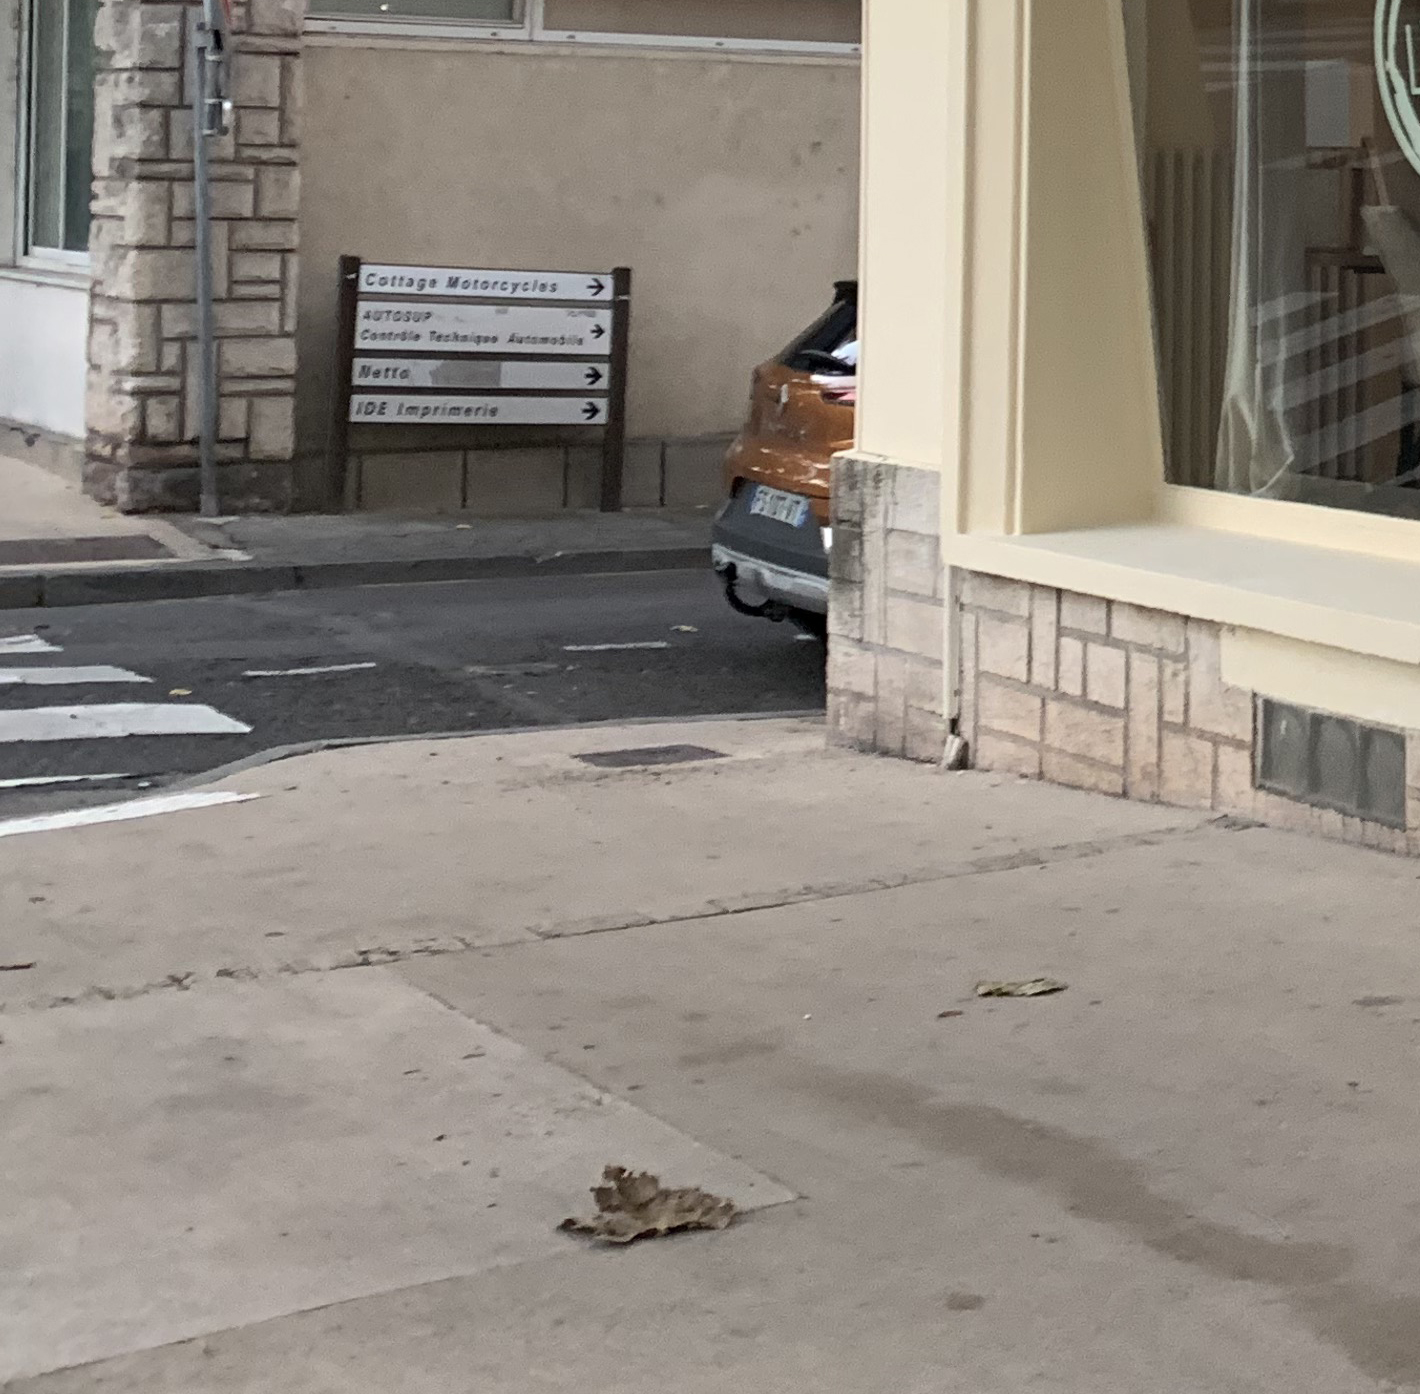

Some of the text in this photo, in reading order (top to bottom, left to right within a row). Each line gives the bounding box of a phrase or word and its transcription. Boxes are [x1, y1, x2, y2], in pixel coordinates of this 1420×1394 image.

[365, 273, 558, 294] Cottage Motorcycles
[429, 330, 498, 345] Technique
[355, 401, 498, 418] IDE Imprimerie
